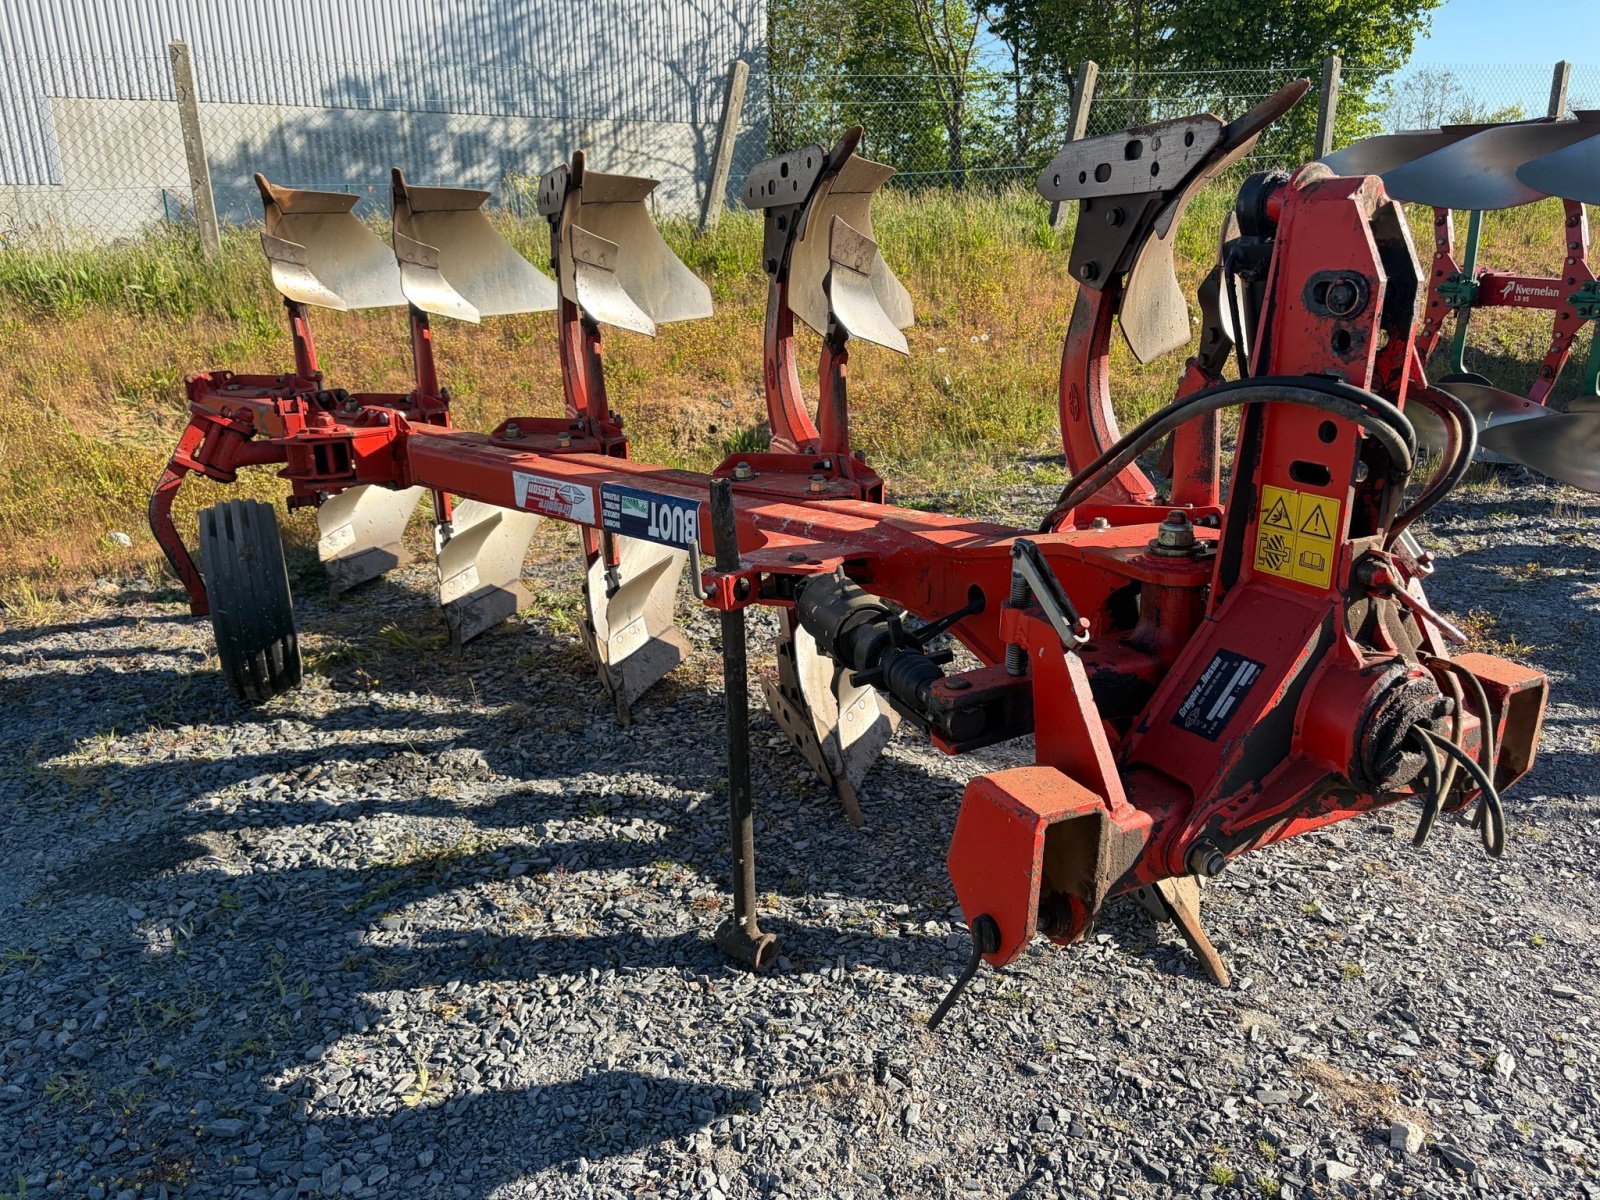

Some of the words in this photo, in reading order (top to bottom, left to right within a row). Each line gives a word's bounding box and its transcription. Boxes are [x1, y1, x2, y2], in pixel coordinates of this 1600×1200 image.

[1515, 284, 1560, 297] Kvernelan
[528, 483, 556, 501] Besson
[538, 499, 572, 518] Grégoire
[648, 502, 697, 544] BUOT
